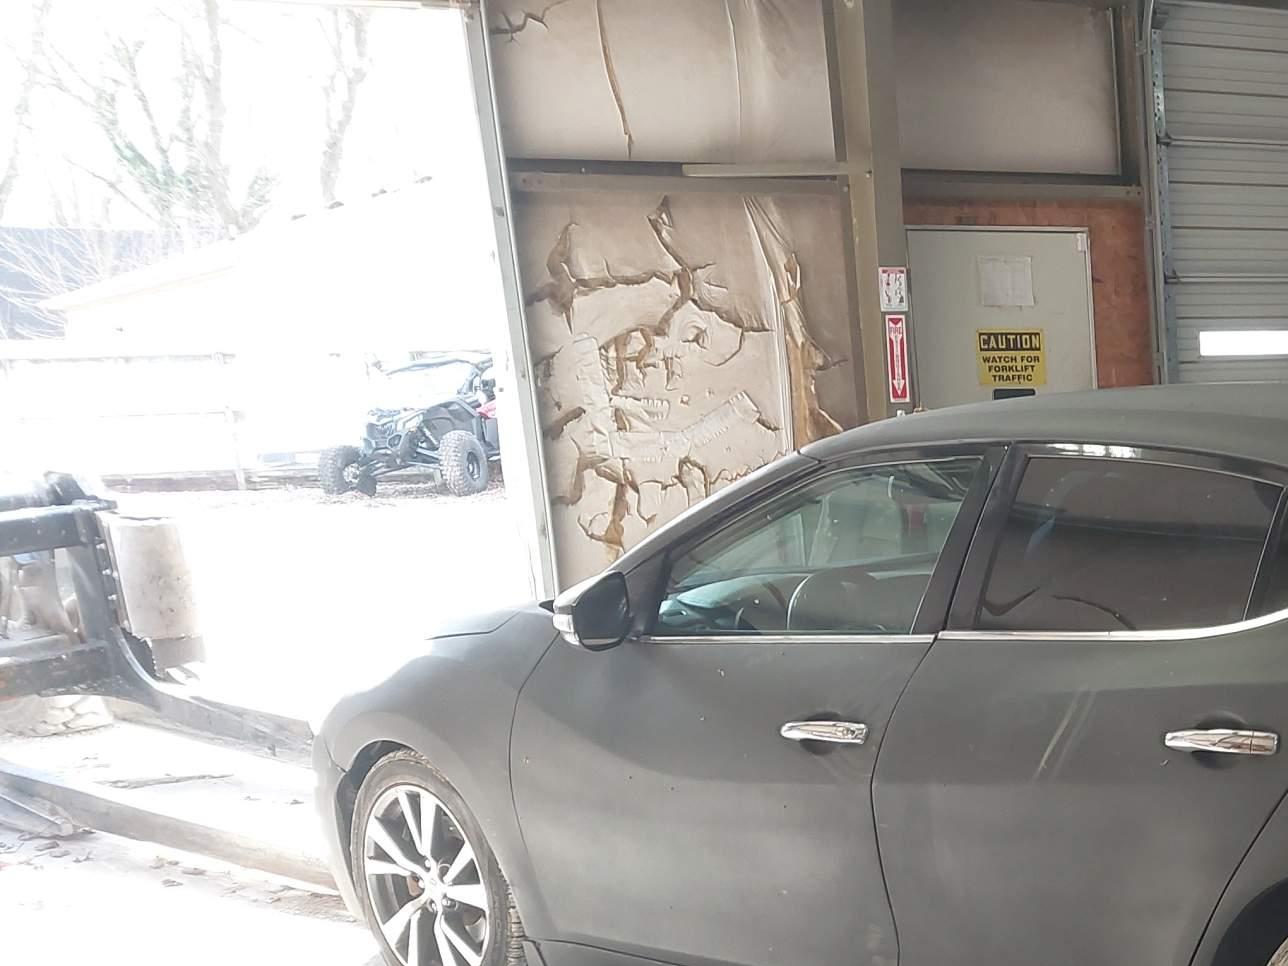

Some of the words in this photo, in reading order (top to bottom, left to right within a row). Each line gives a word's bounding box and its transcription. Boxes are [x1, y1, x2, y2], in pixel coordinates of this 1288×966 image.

[979, 334, 1040, 349] CAUTION
[982, 355, 1017, 364] WATCH
[1020, 355, 1040, 364] FOR
[988, 364, 1036, 373] FORKLIFT
[992, 374, 1033, 382] TRAFFIC
